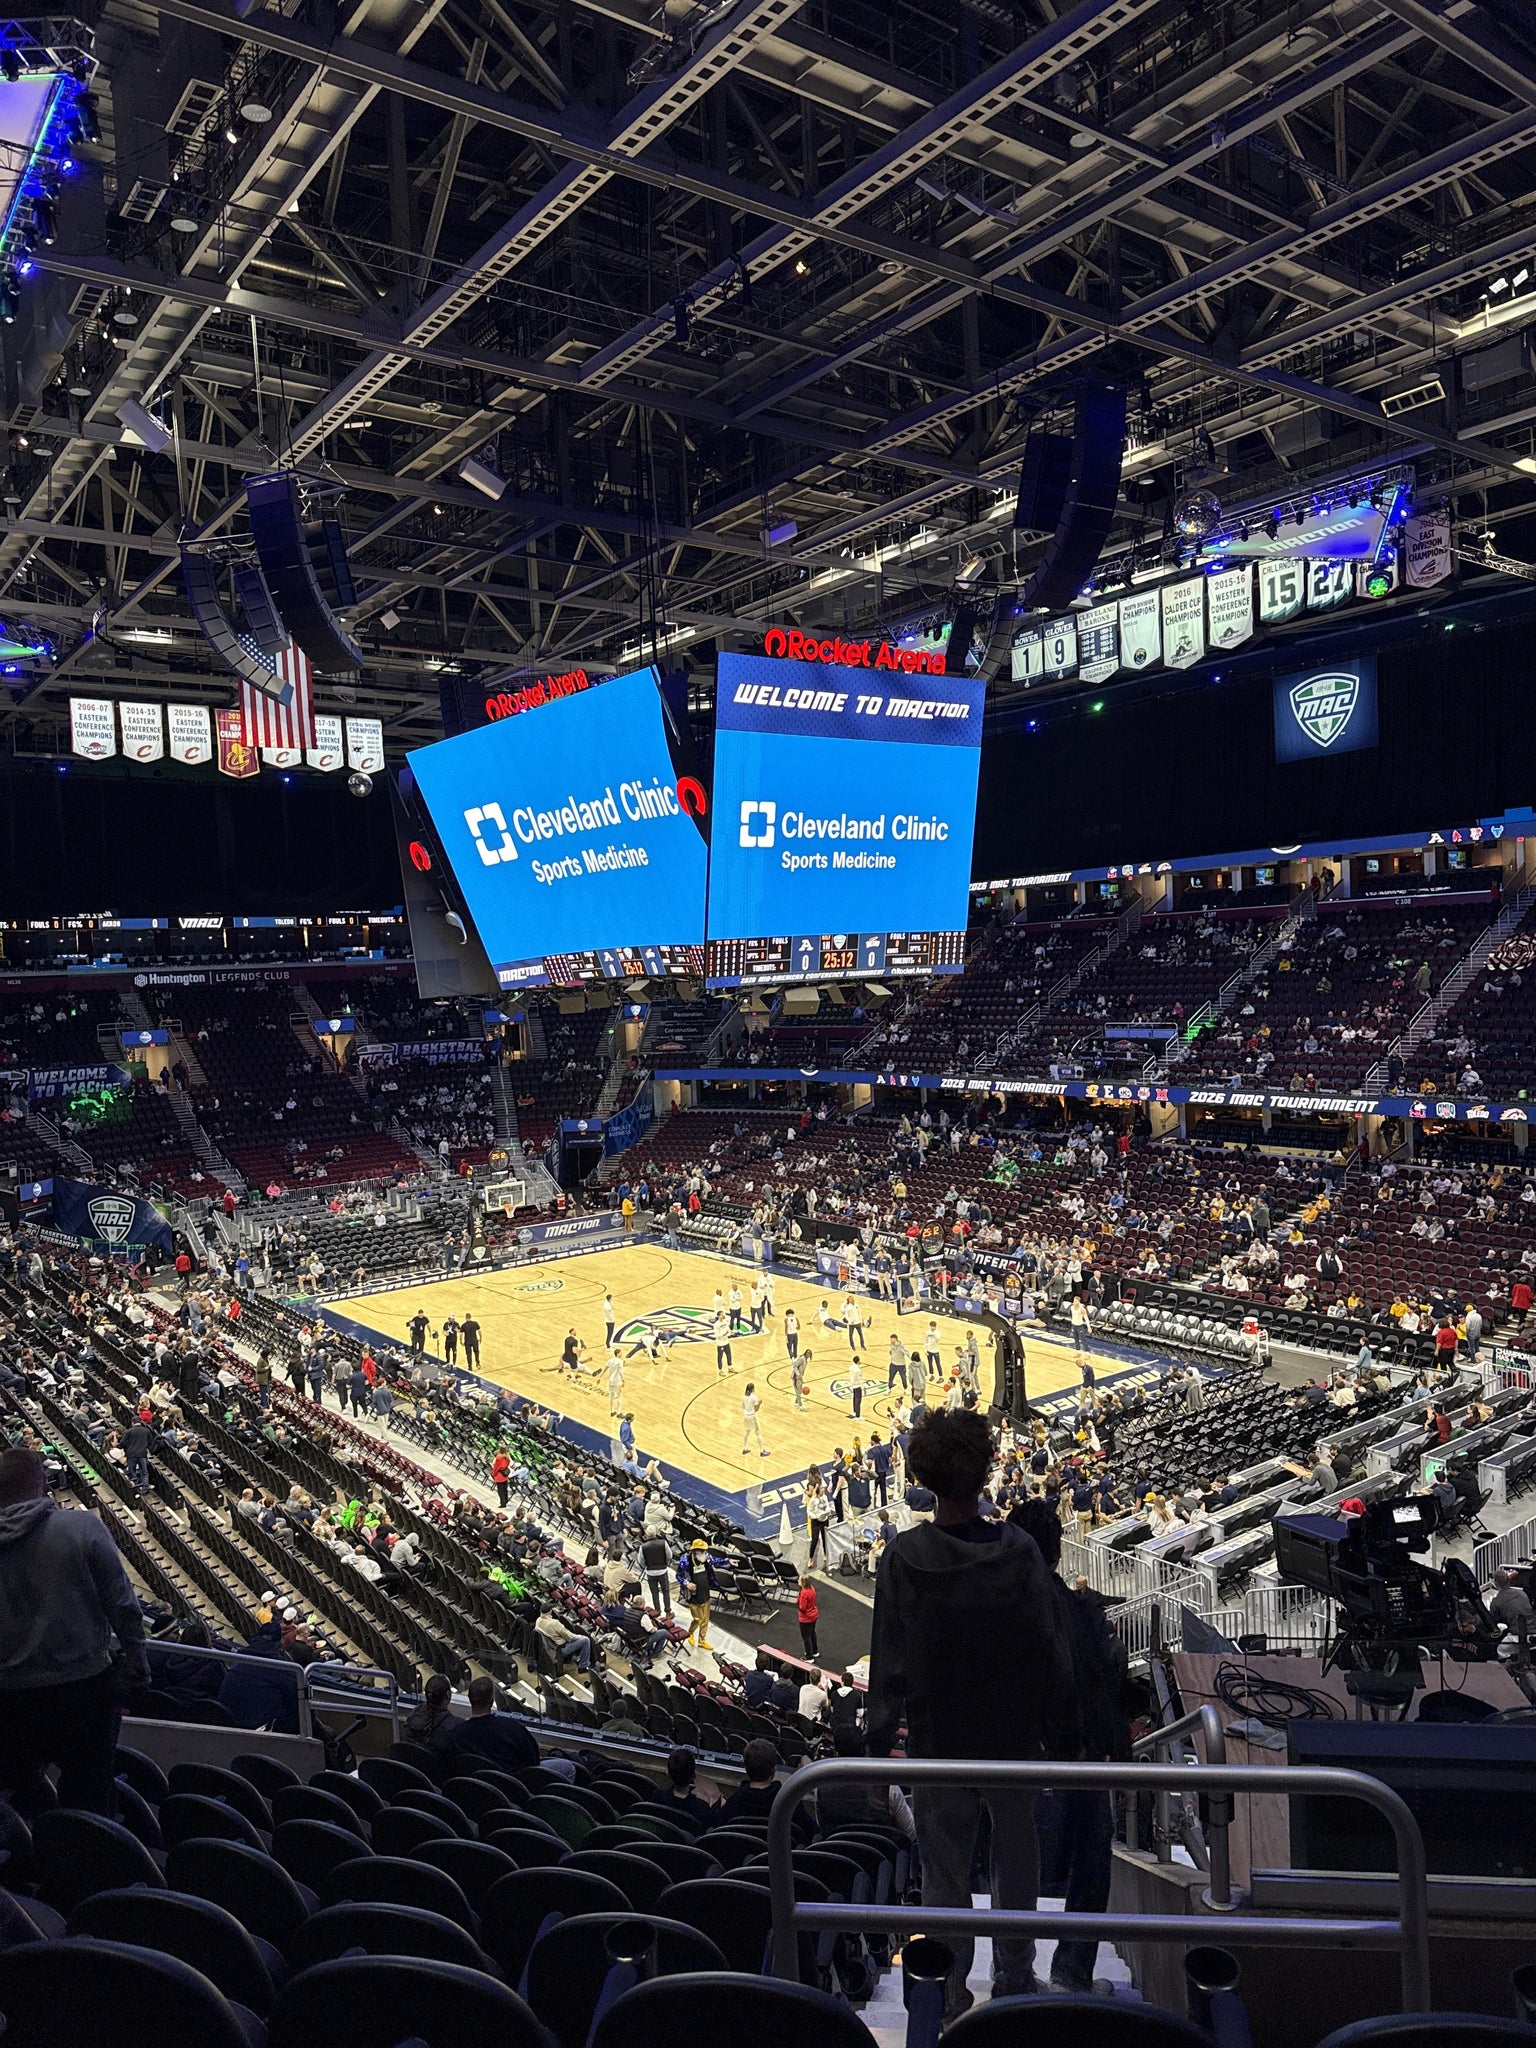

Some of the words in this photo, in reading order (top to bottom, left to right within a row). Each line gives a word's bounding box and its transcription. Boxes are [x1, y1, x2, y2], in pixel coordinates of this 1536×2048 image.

[1263, 519, 1365, 553] MACTION
[1419, 529, 1435, 540] EAST
[1413, 536, 1443, 552] DIVISION
[1409, 546, 1448, 562] CHAMPIONS
[1214, 574, 1246, 591] 2015-16
[1267, 572, 1296, 608] 15
[1173, 588, 1192, 599] 2016
[1215, 588, 1246, 602] WESTERN
[1123, 605, 1156, 621] CHAMPIONS
[1164, 601, 1188, 615] CALDER
[1211, 597, 1250, 614] CONFERENCE
[1078, 605, 1116, 622] CLEVELAND
[1165, 608, 1202, 626] CHAMPIONS
[1213, 608, 1249, 624] CHAMPIONS
[1045, 622, 1074, 637] GLOVER
[1014, 634, 1039, 646] BOWER
[788, 629, 871, 667] Rocket
[874, 641, 947, 674] Arena
[1055, 639, 1065, 665] 9
[1022, 647, 1030, 675] 1
[498, 679, 550, 718] Rocket
[547, 668, 589, 697] Arena
[733, 683, 849, 713] WELCOME
[855, 695, 884, 715] TO
[77, 702, 108, 713] 2006-07
[126, 707, 156, 716] 2014-15
[174, 708, 204, 717] 2015-16
[1298, 693, 1353, 719] MAC
[79, 713, 108, 722] EASTERN
[128, 717, 155, 725] EASTERN
[176, 718, 203, 727] EASTERN
[74, 722, 114, 731] CONFERENCE
[124, 725, 161, 734] CONFERENCE
[172, 726, 209, 736] CONFERENCE
[349, 727, 380, 735] CHAMPIONS
[76, 730, 113, 739] CHAMPIONS
[126, 733, 160, 742] CHAMPIONS
[512, 787, 622, 844] Cleveland
[619, 776, 679, 822] Clinic
[781, 811, 885, 840] Cleveland
[891, 814, 949, 841] Clinic
[531, 854, 583, 886] Sports
[581, 843, 649, 874] Medicine
[781, 851, 828, 872] Sports
[832, 851, 896, 869] Medicine
[989, 880, 1009, 889] MAC
[1012, 872, 1073, 887] TOURNAMENT
[30, 921, 50, 929] FOULS
[54, 921, 59, 929] 0
[88, 920, 94, 928] 0
[152, 918, 158, 928] 0
[242, 918, 249, 927] 0
[802, 955, 810, 971] 0
[823, 951, 853, 969] 25:12
[868, 951, 876, 967] 0
[624, 961, 645, 975] 25:12
[150, 973, 206, 986] Huntington
[264, 971, 290, 980] CLUB
[34, 1067, 107, 1084] WELCOME
[35, 1084, 55, 1098] TO
[940, 1078, 965, 1089] 2026
[967, 1079, 992, 1091] MAC
[994, 1081, 1068, 1095] TOURNAMENT
[1189, 1091, 1225, 1103] 2026
[1229, 1093, 1265, 1107] MAC
[1270, 1095, 1379, 1113] TOURNAMENT
[94, 1213, 130, 1225] MAC
[39, 1235, 80, 1250] TOURNAMENT
[40, 1229, 78, 1243] BASKETBALL
[1495, 1347, 1530, 1360] CHAMPION
